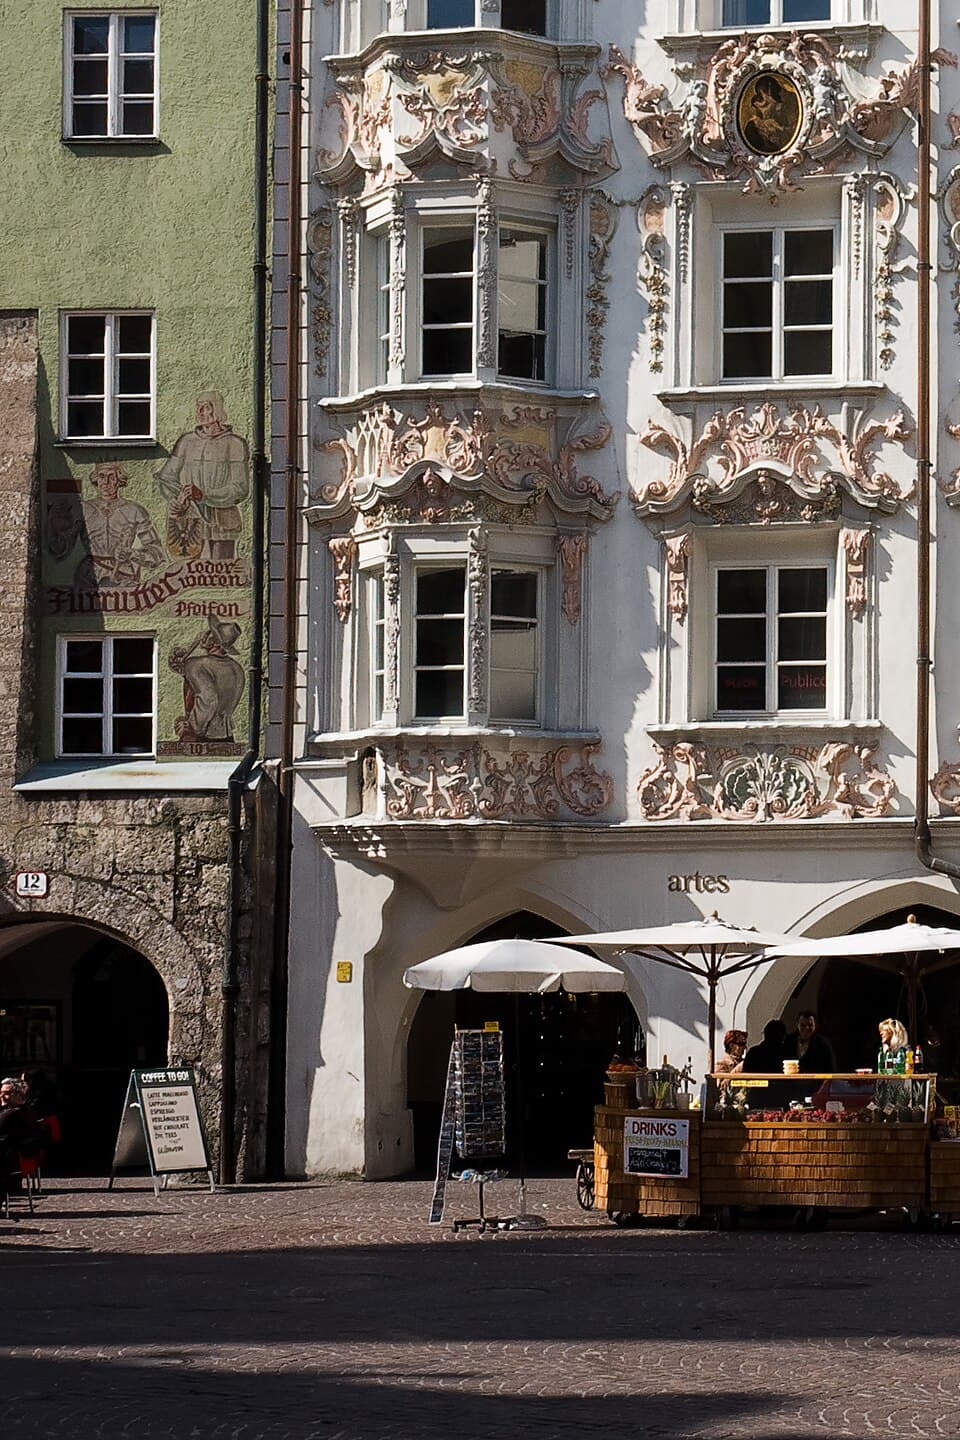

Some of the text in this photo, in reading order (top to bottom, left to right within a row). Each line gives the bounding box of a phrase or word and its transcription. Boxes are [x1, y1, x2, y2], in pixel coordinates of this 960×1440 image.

[178, 573, 248, 587] waren
[175, 600, 249, 617] Pfeifen
[24, 873, 40, 889] 12
[668, 871, 730, 893] artes
[141, 1071, 189, 1083] COFFEE TO GO!
[632, 1121, 677, 1136] DRINKS
